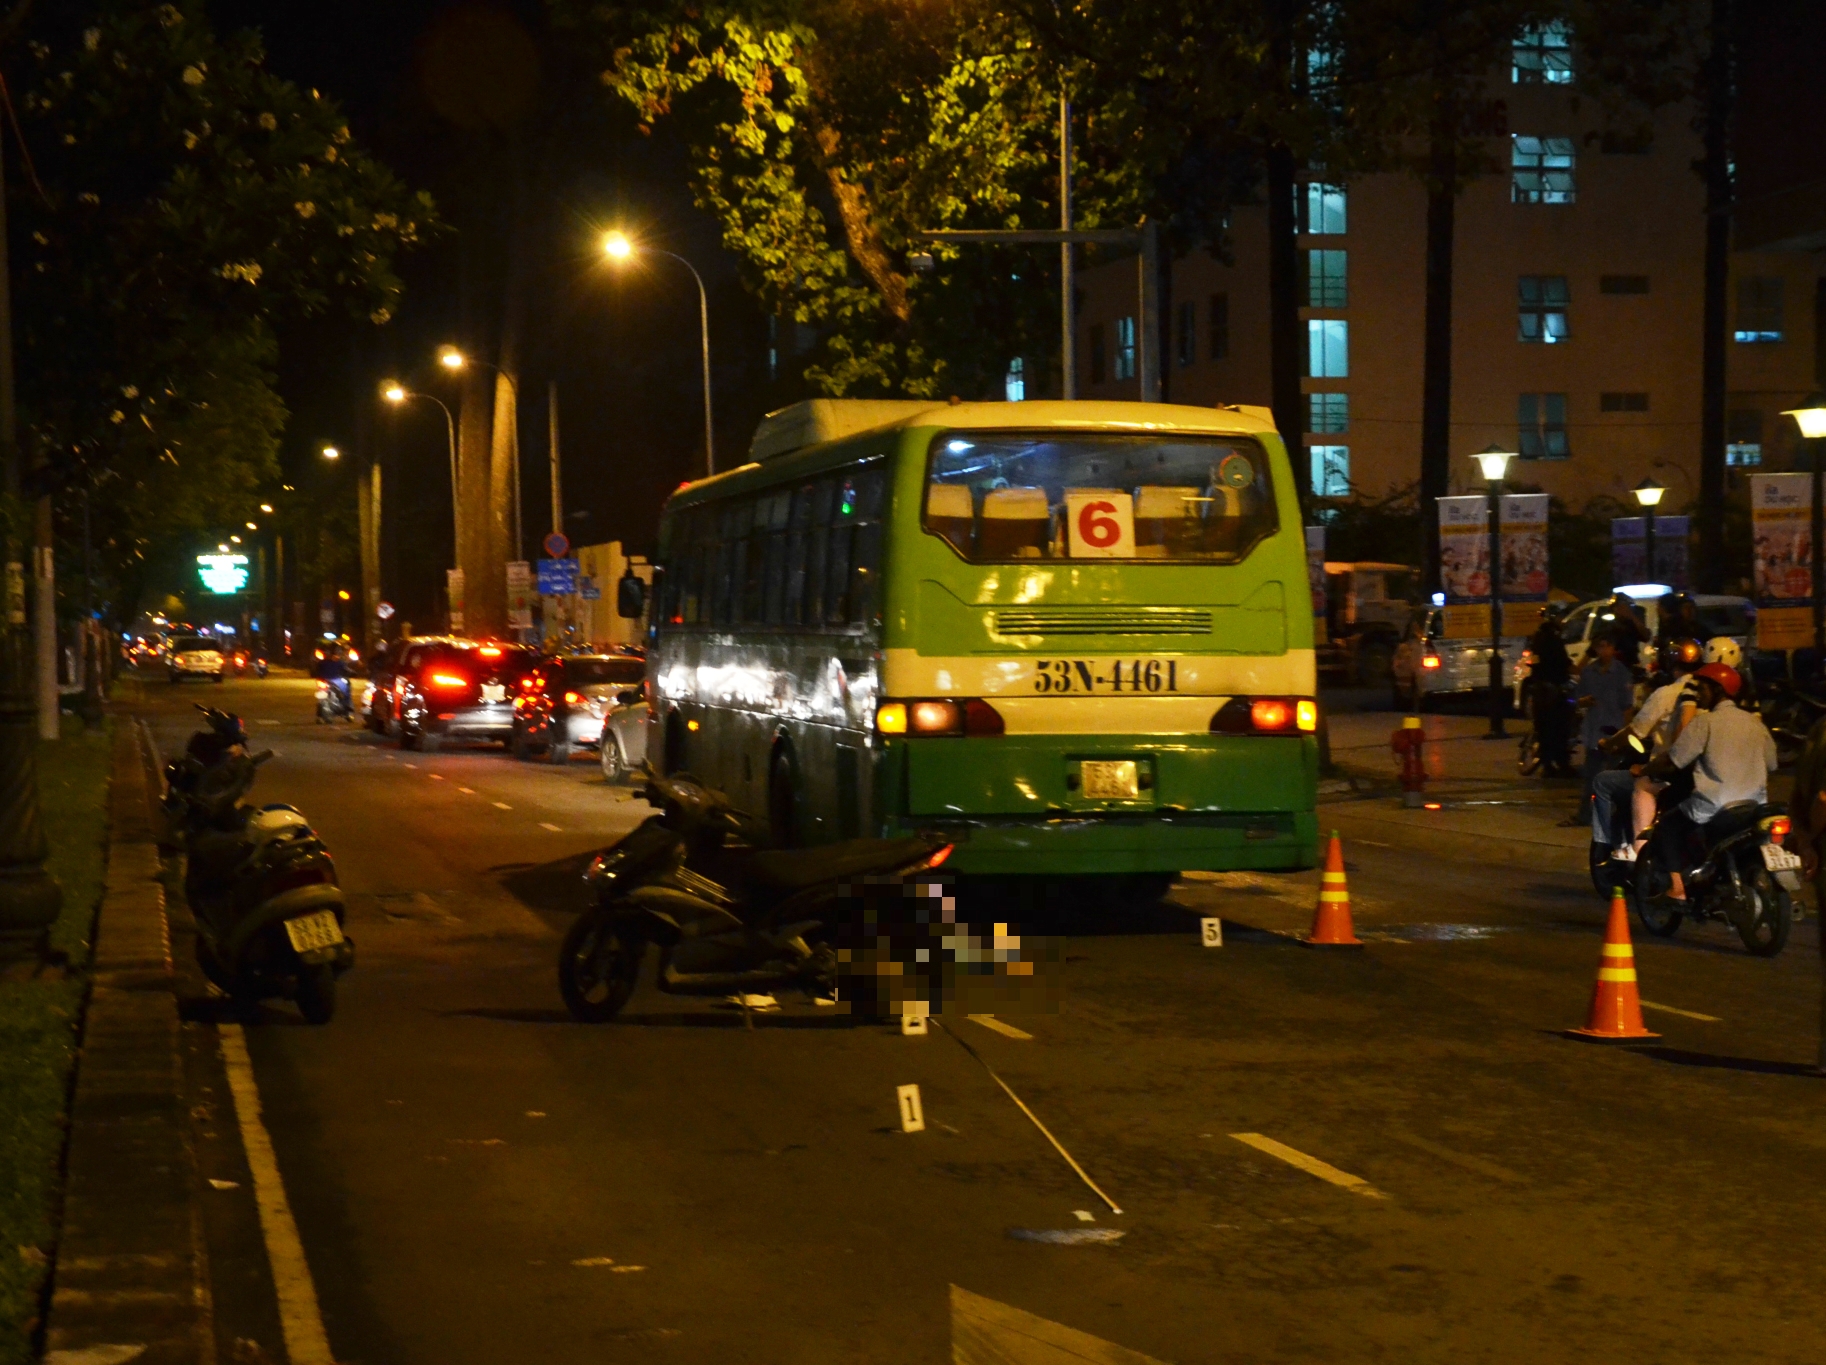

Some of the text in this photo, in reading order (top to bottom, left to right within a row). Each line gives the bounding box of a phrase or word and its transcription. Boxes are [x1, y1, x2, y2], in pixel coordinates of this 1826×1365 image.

[1078, 500, 1121, 549] 6
[1035, 660, 1178, 693] 53N-4461
[1206, 923, 1218, 942] 5
[904, 1095, 917, 1122] 1
